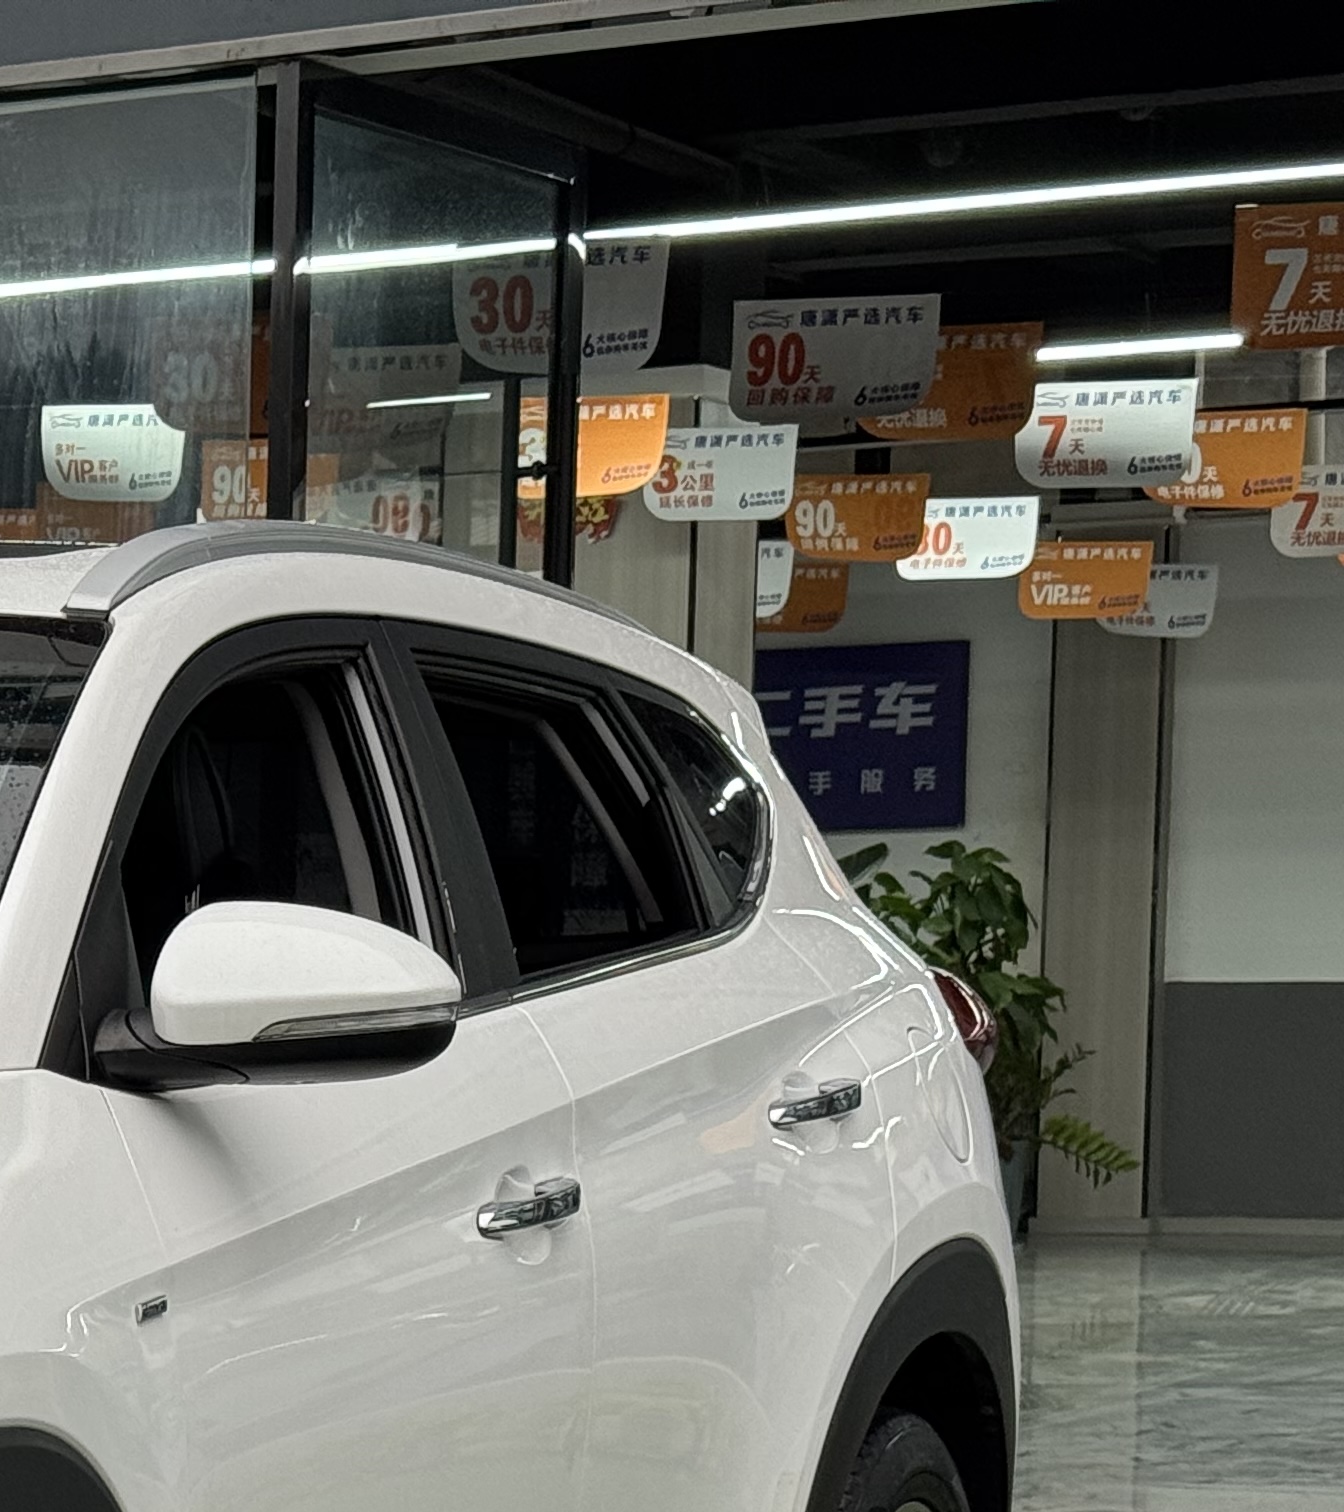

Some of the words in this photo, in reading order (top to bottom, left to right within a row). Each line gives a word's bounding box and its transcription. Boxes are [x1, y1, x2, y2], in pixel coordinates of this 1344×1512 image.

[1264, 246, 1310, 312] 7
[470, 275, 535, 335] 30
[1308, 281, 1332, 305] 天
[800, 305, 925, 328] 唐潇严选汽车
[746, 331, 806, 387] 90
[804, 365, 822, 384] 天
[1074, 389, 1184, 407] 唐潇严选汽车
[1037, 414, 1068, 461] 7
[1068, 437, 1085, 455] 天
[54, 458, 95, 485] VIP
[651, 454, 679, 494] 3
[680, 473, 715, 492] 公里
[1202, 463, 1218, 483] 天
[738, 491, 749, 510] 6
[1291, 491, 1320, 531] 7
[793, 499, 836, 538] 90
[1319, 512, 1334, 528] 天
[1030, 584, 1070, 607] VIP
[755, 681, 939, 738] 二手车
